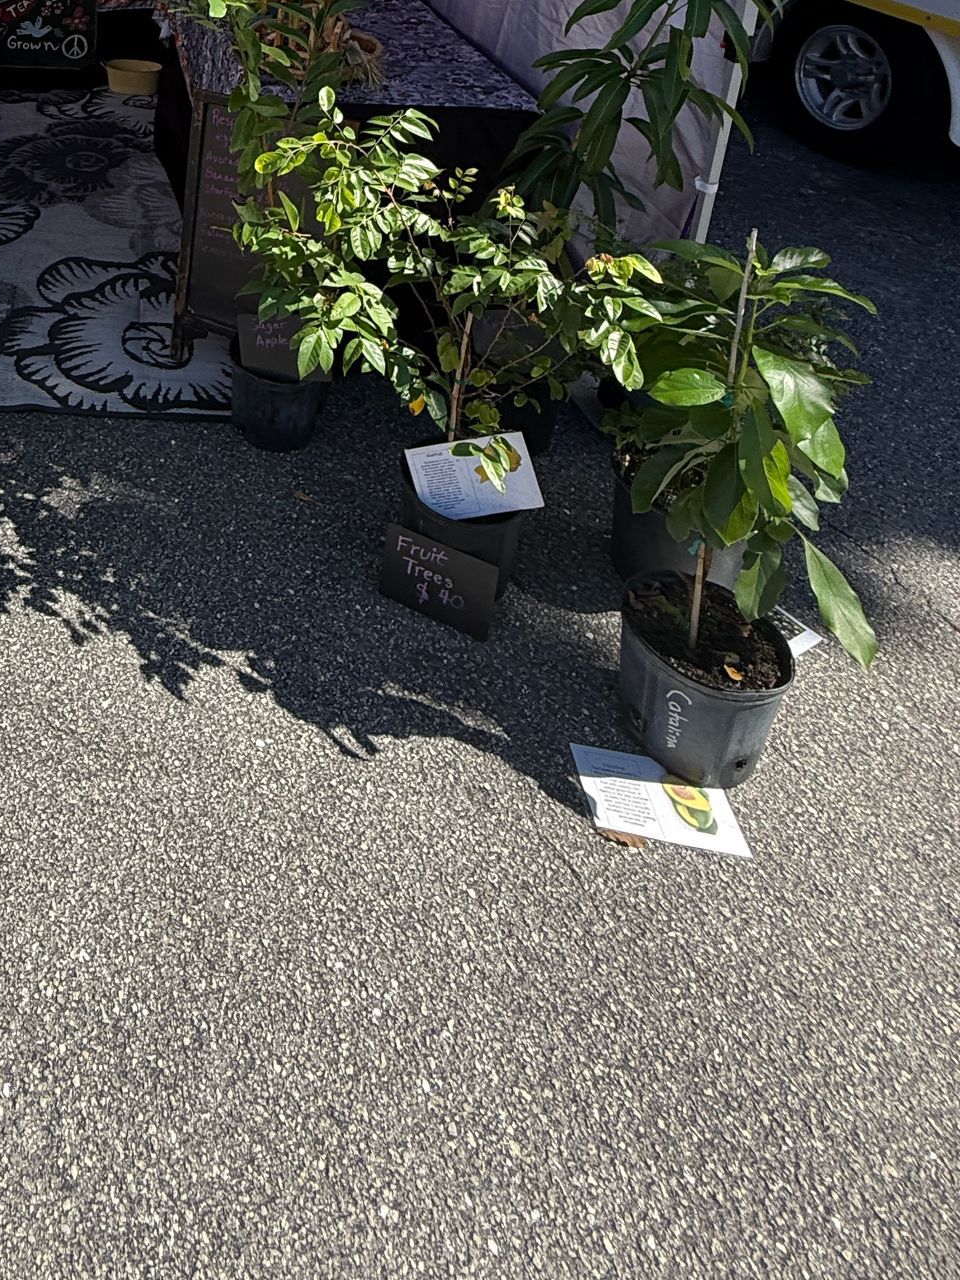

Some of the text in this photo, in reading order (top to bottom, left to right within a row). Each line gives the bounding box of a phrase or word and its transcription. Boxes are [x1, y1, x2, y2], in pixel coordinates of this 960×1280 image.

[6, 34, 60, 52] Grown
[255, 333, 290, 349] Apple
[396, 535, 449, 567] Fruit
[402, 556, 454, 589] Trees
[439, 588, 465, 610] 40
[666, 689, 693, 749] Catalina
